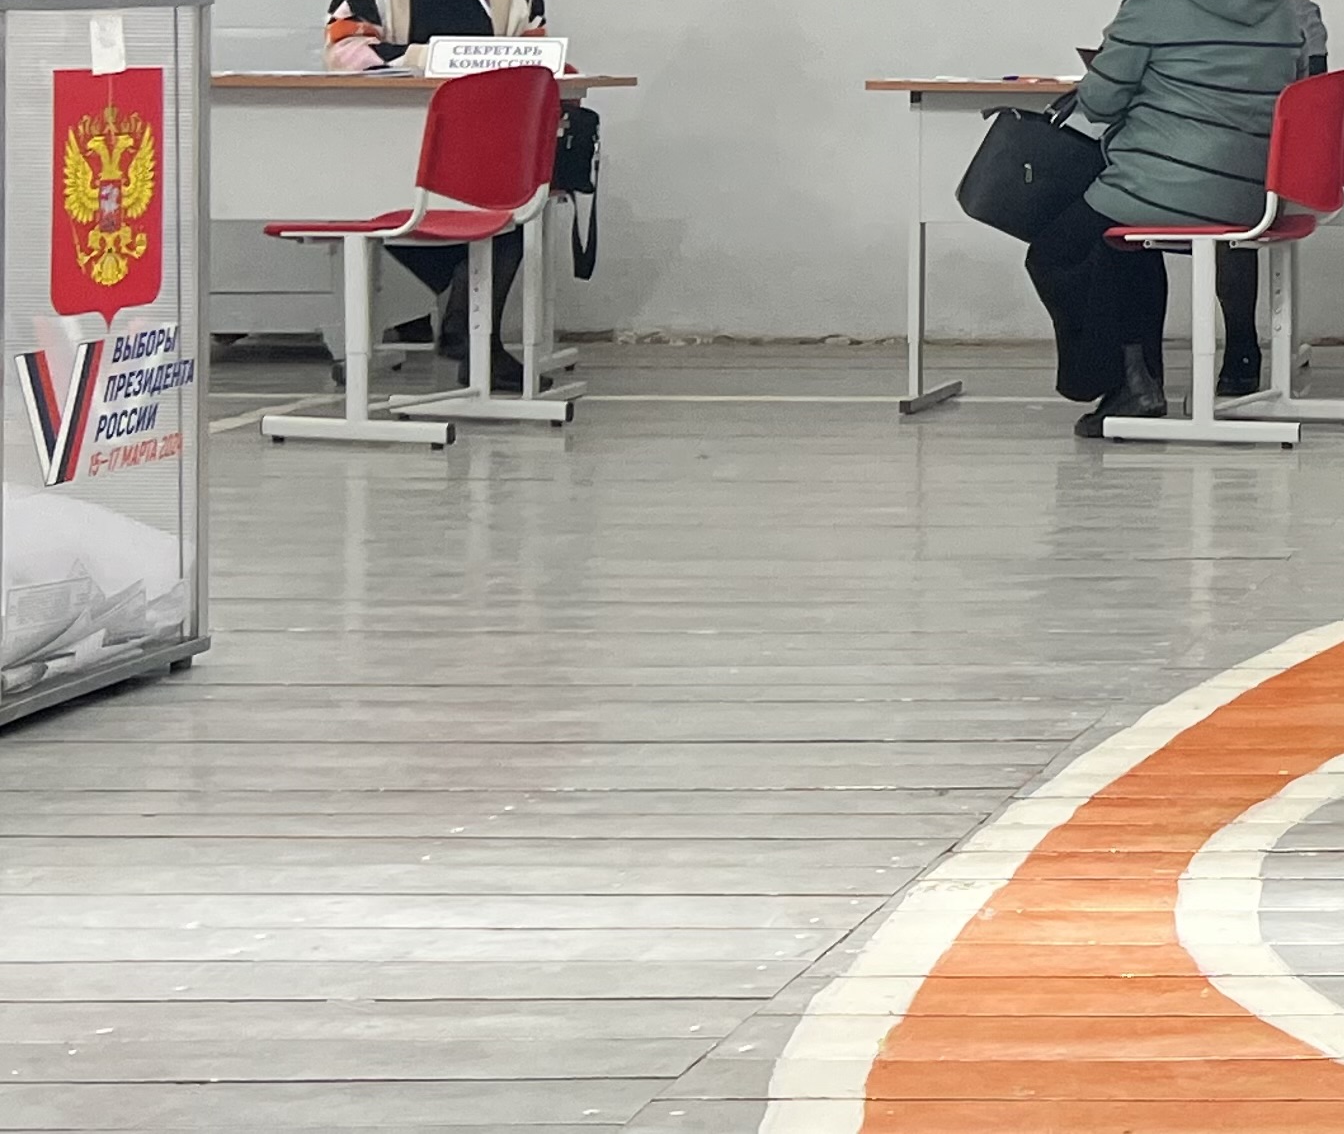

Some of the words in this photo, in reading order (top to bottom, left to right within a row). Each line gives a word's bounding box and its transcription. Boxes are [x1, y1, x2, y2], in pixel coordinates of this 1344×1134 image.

[452, 45, 543, 57] СЕКРЕТАРЬ
[112, 326, 178, 364] ВЫБОРЫ
[103, 358, 195, 403] ПРЕЗИДЕНТА
[94, 403, 159, 443] РОССИИ
[122, 437, 159, 468] МАРТА
